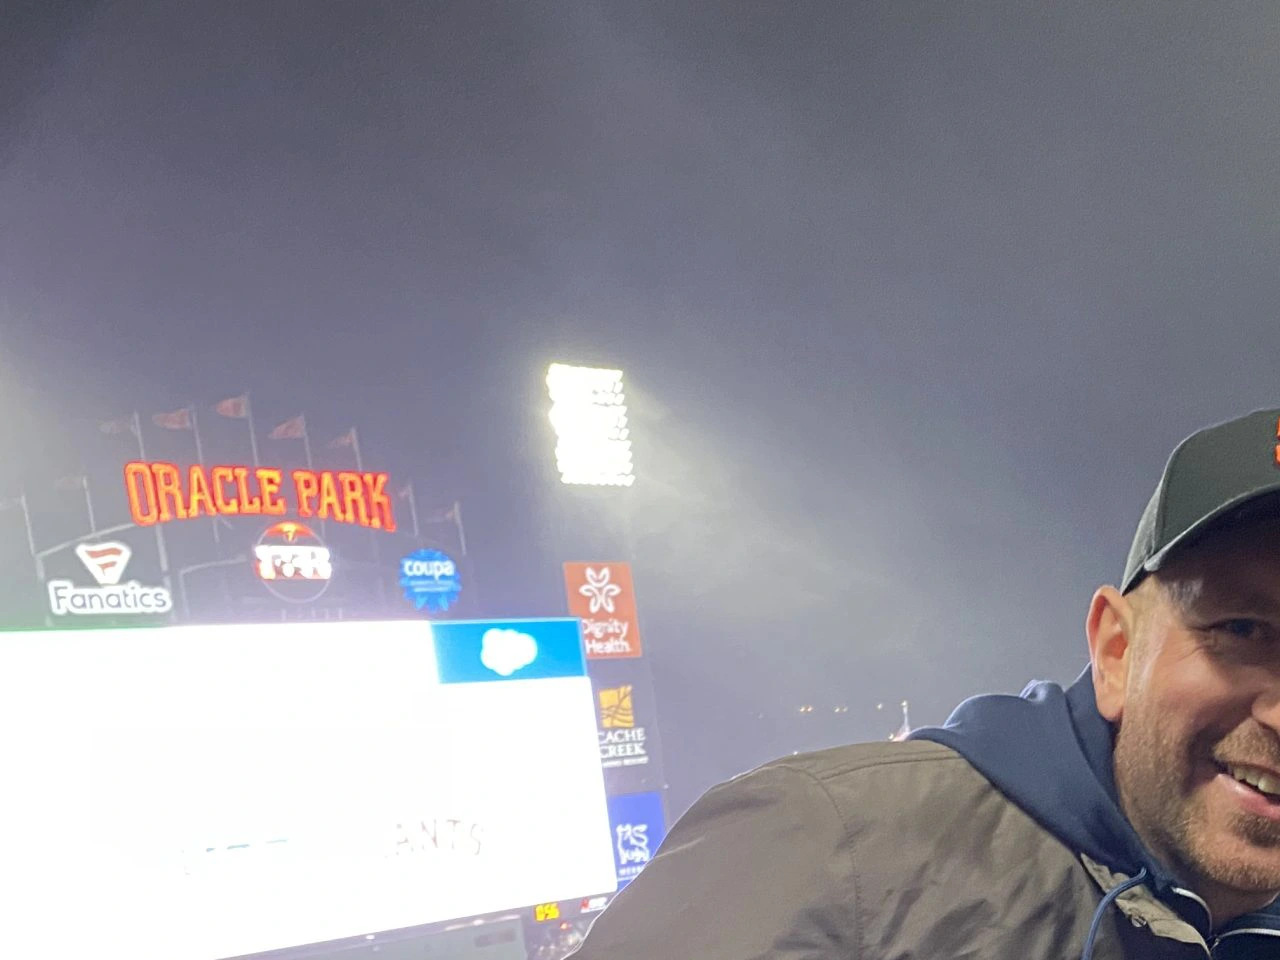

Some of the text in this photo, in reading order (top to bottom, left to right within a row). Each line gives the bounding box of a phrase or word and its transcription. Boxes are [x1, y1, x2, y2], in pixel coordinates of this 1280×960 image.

[125, 461, 396, 532] ORACLE PARK
[403, 560, 454, 580] coupa
[52, 583, 168, 611] Fanatics
